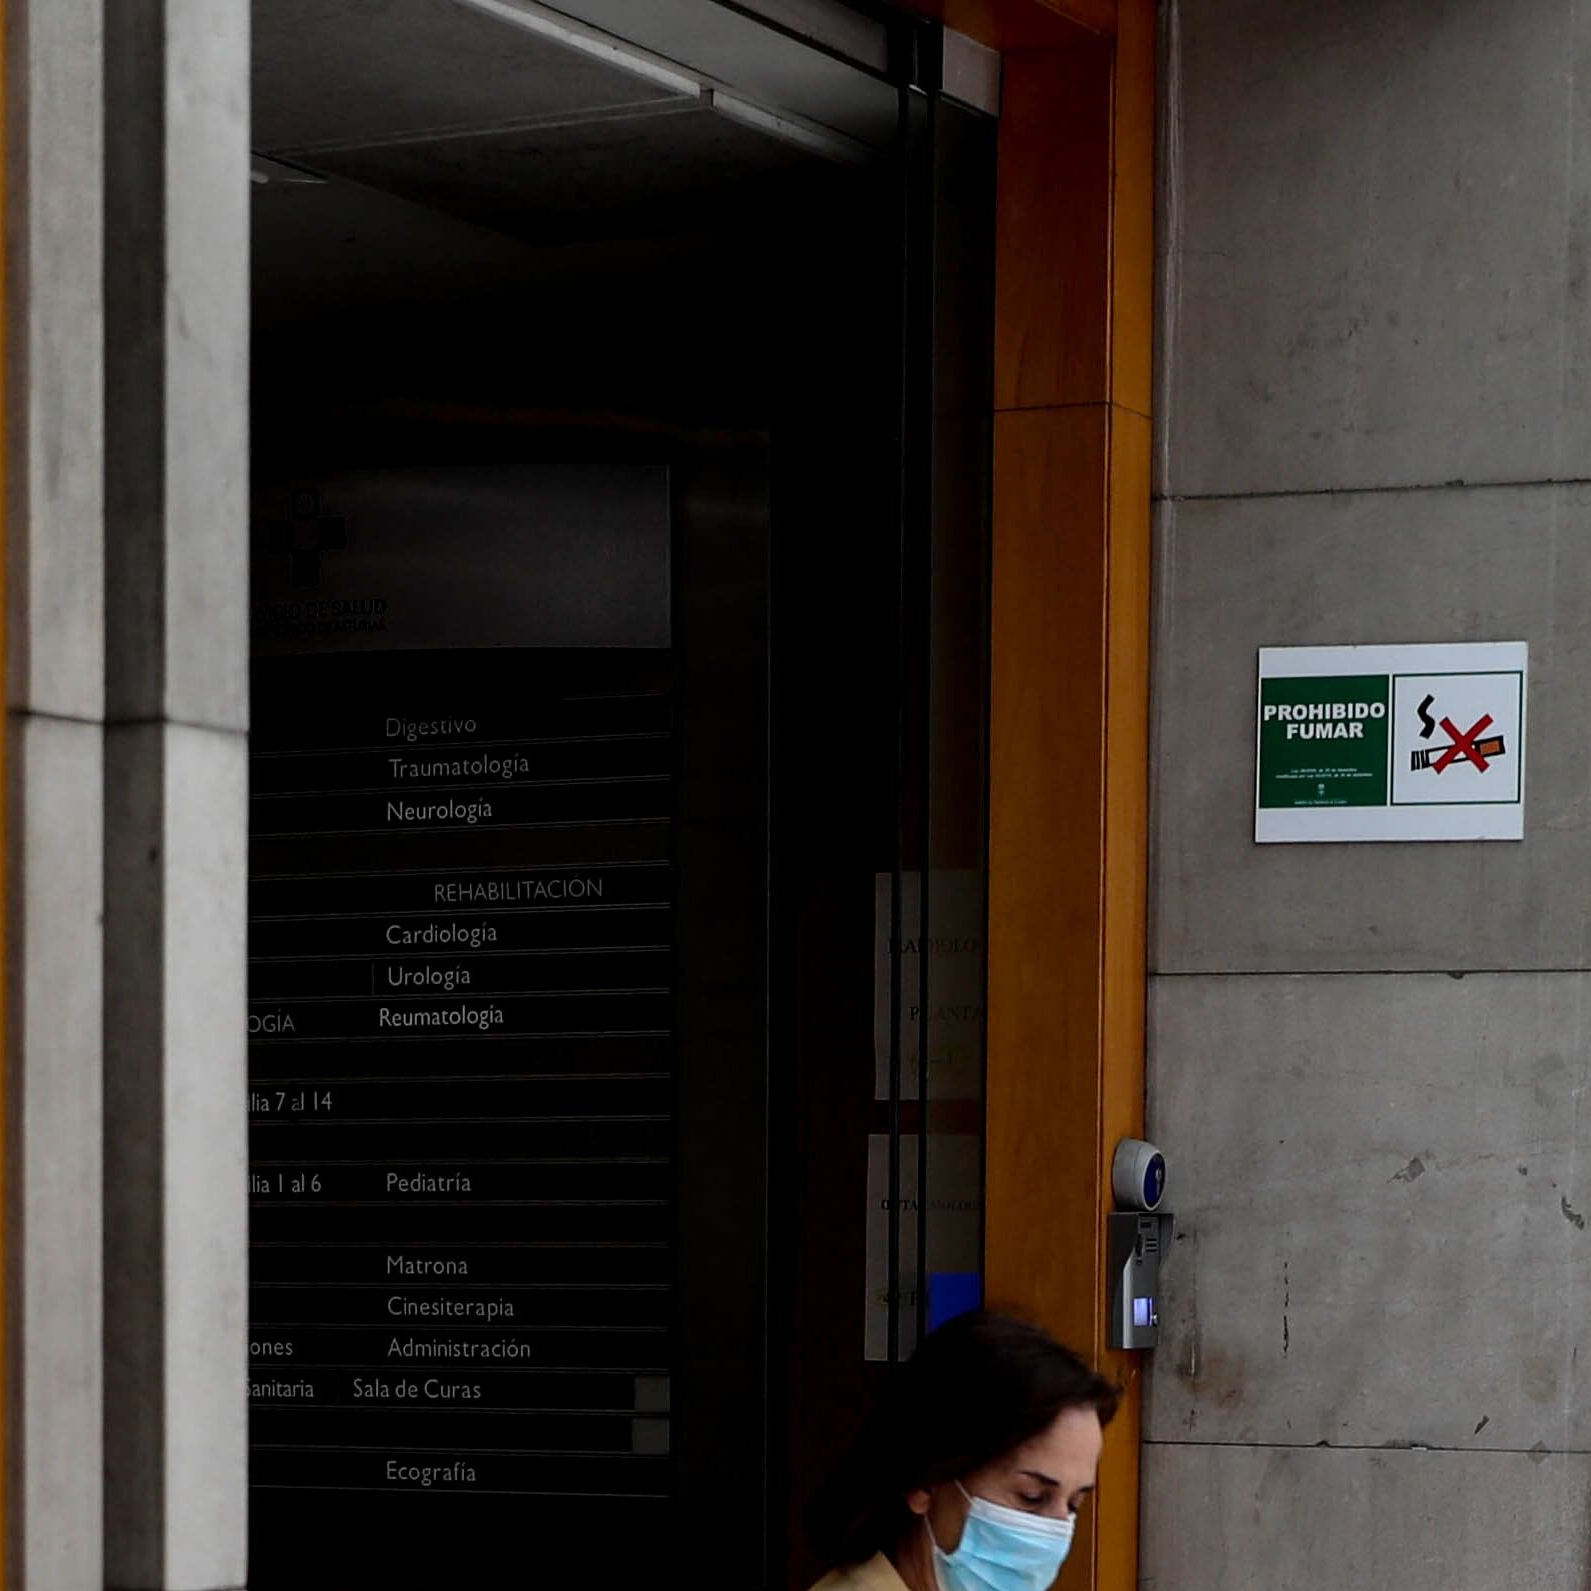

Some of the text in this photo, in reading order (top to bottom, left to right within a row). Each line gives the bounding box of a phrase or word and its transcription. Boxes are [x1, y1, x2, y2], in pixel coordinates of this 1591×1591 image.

[1263, 702, 1386, 721] PROHIBIDO
[386, 714, 477, 742] Digestivo
[1286, 722, 1364, 740] FUMAR
[388, 752, 530, 779] Traumatología
[386, 796, 493, 824] Neurología
[434, 874, 604, 904] REHABILITACIÓN
[385, 920, 498, 949] Cardiología
[387, 963, 472, 991] Urología
[379, 1002, 505, 1029] Reumatología
[275, 1091, 286, 1112] 7
[291, 1090, 305, 1111] al
[313, 1090, 332, 1111] 14
[291, 1173, 305, 1193] al
[310, 1172, 322, 1193] 6
[386, 1171, 472, 1193] Pediatría
[386, 1255, 469, 1275] Matrona
[387, 1296, 515, 1323] Cinesiterapia
[386, 1336, 531, 1358] Administración
[353, 1376, 482, 1399] Sala de Curas
[386, 1459, 478, 1487] Ecografía
